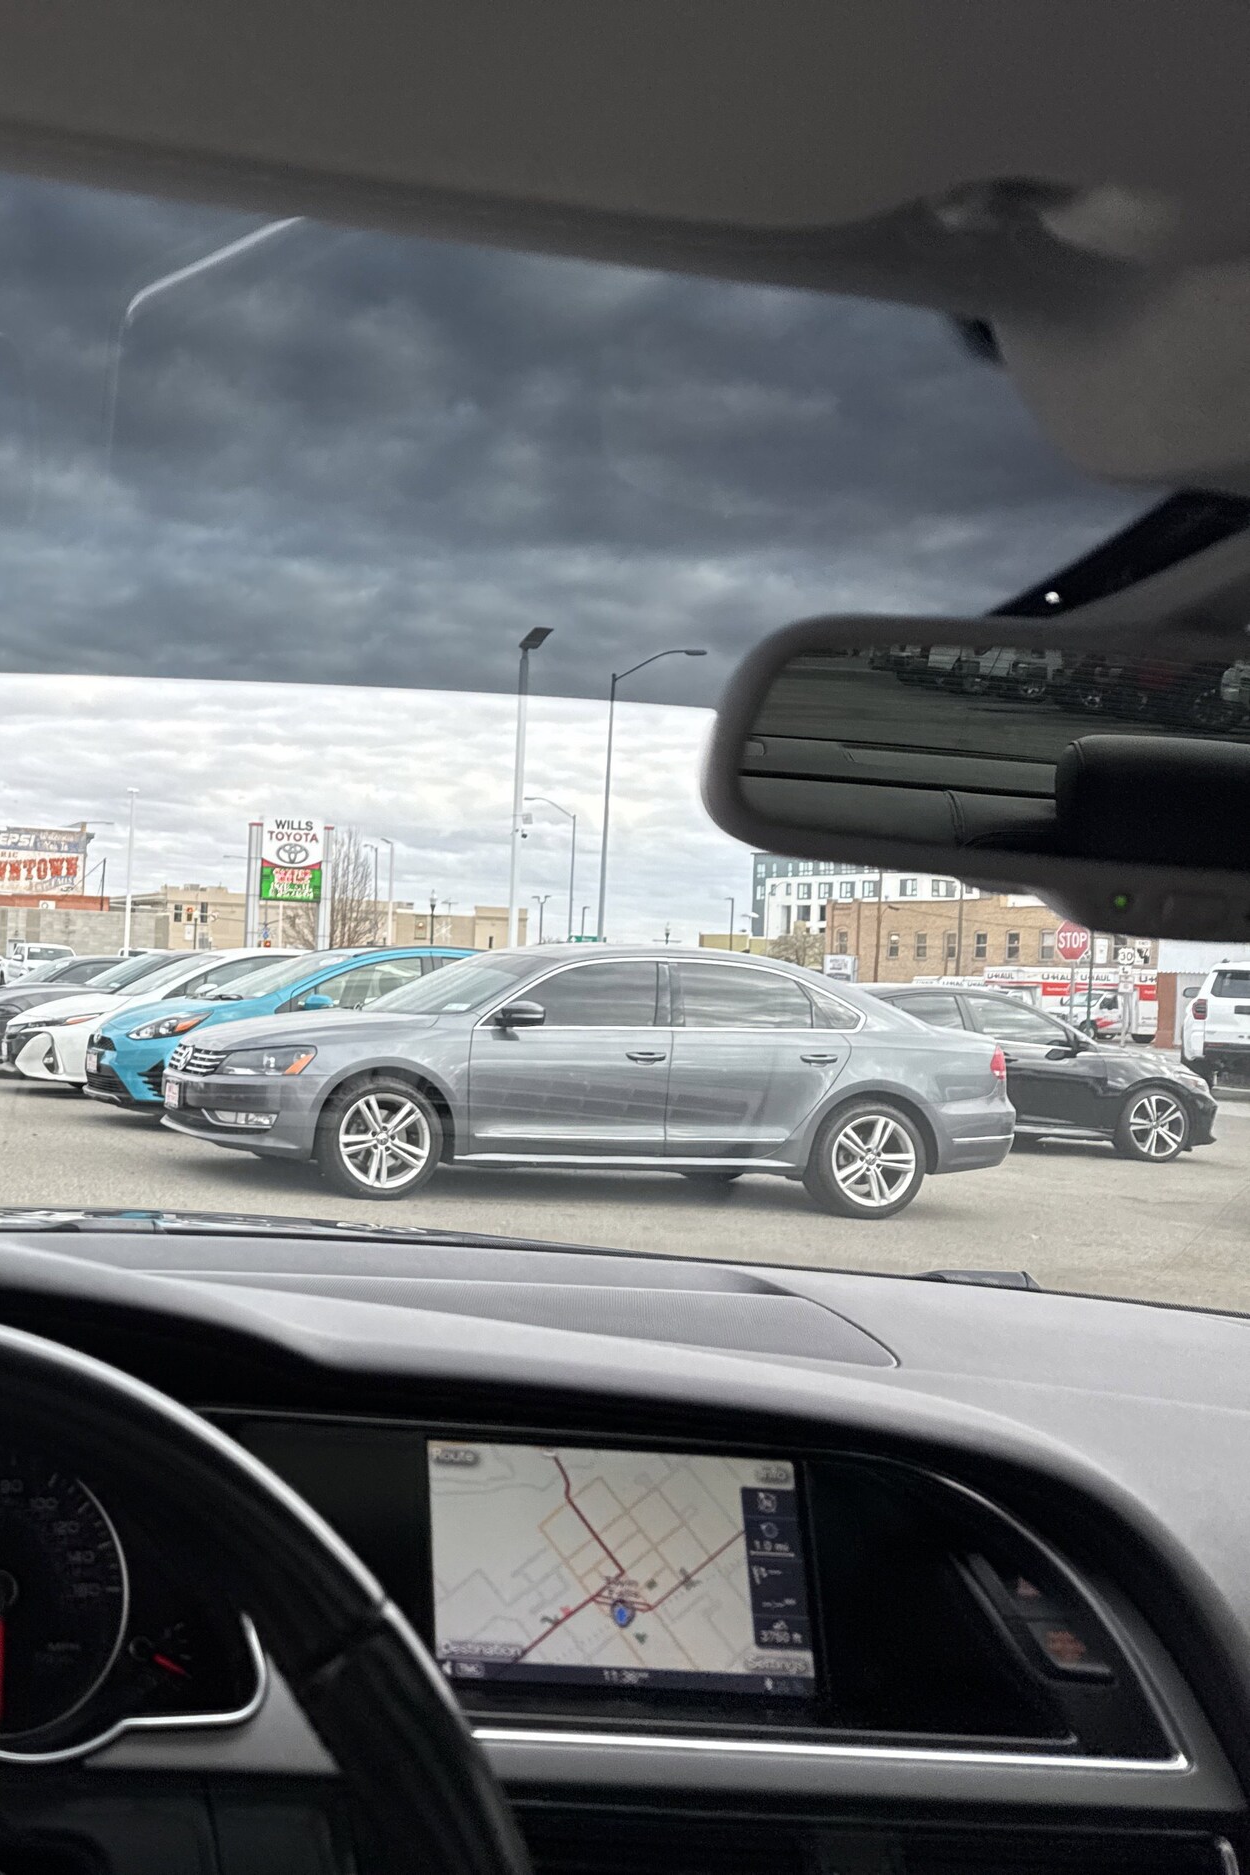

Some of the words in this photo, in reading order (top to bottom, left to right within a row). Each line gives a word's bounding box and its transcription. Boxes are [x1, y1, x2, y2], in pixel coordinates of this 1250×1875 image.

[275, 819, 313, 832] WILLS
[267, 830, 319, 843] TOYOTA
[1058, 931, 1087, 949] STOP
[1120, 951, 1133, 961] 30
